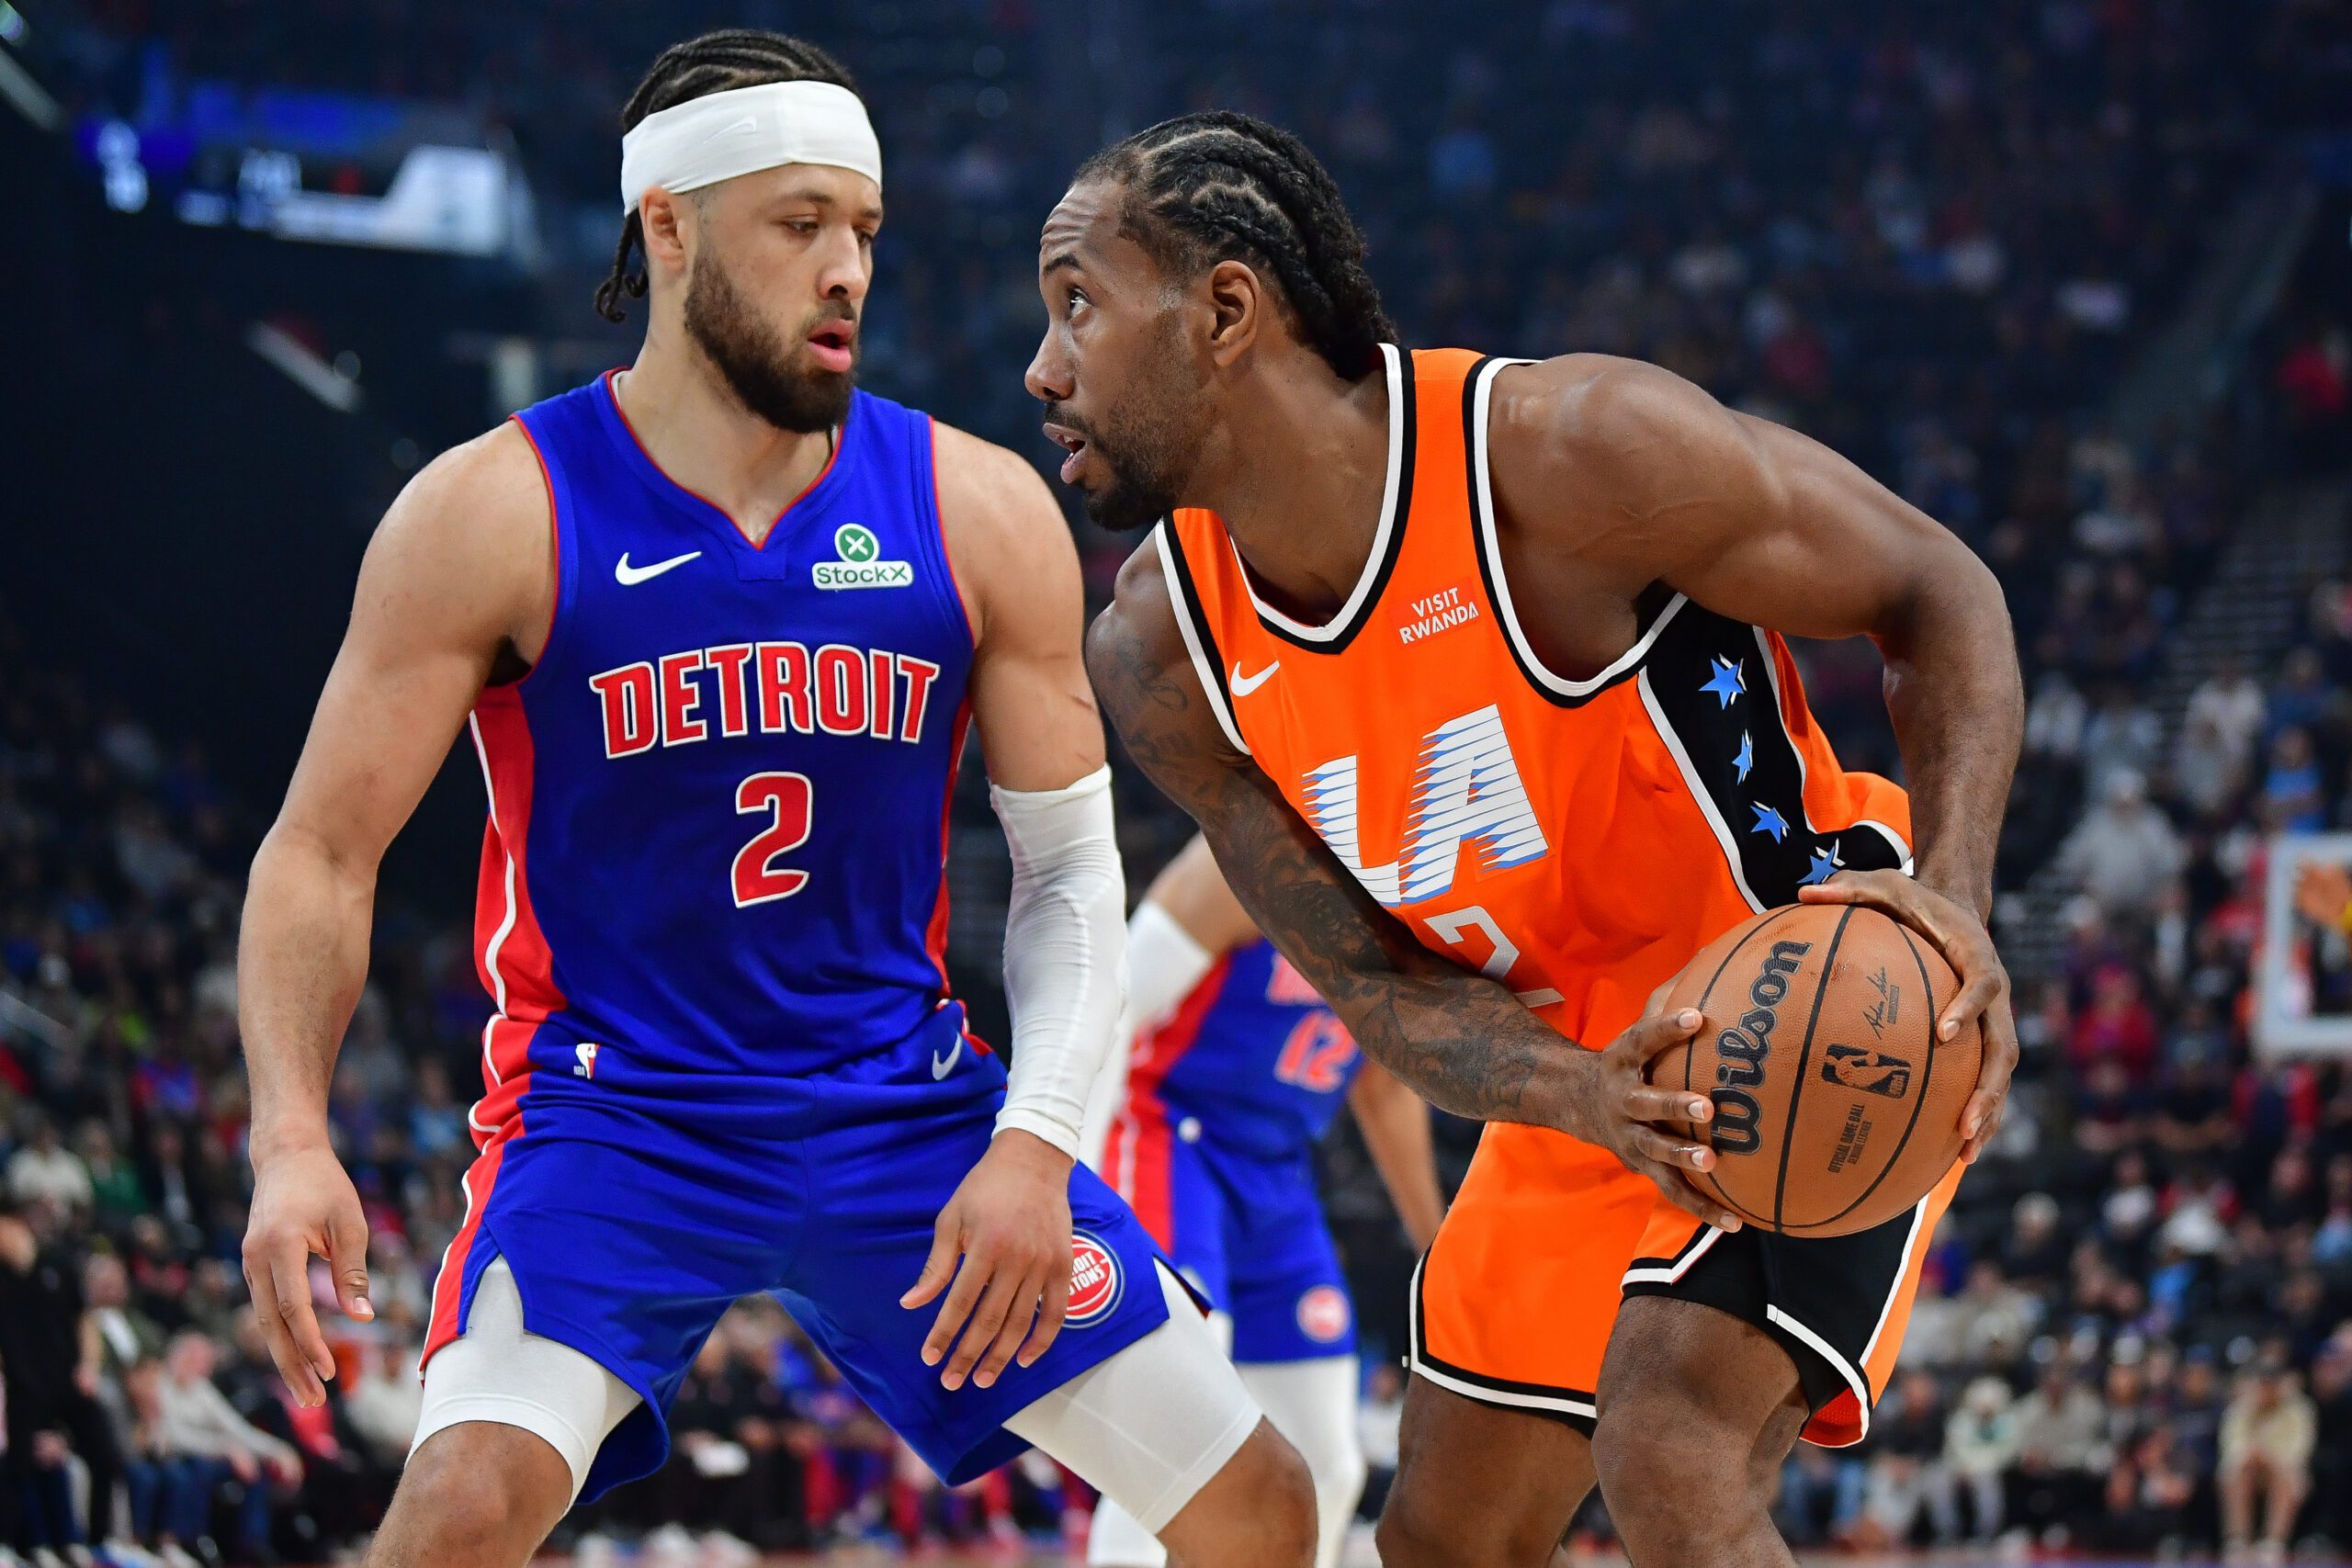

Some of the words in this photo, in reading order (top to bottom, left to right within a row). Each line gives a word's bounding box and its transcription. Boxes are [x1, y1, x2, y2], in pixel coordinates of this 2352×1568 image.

[816, 564, 908, 584] StockX
[1410, 587, 1459, 618] VISIT
[1398, 601, 1479, 645] RWANDA
[588, 640, 941, 760] DETROIT
[1301, 703, 1550, 908] LA
[731, 771, 813, 908] 2
[1423, 905, 1566, 1010] 2
[1274, 1011, 1360, 1093] 12
[1710, 940, 1814, 1156] Wilson
[1839, 1122, 1859, 1145] GAME
[1848, 1103, 1865, 1122] BALL
[1827, 1144, 1851, 1174] OFFICIAL
